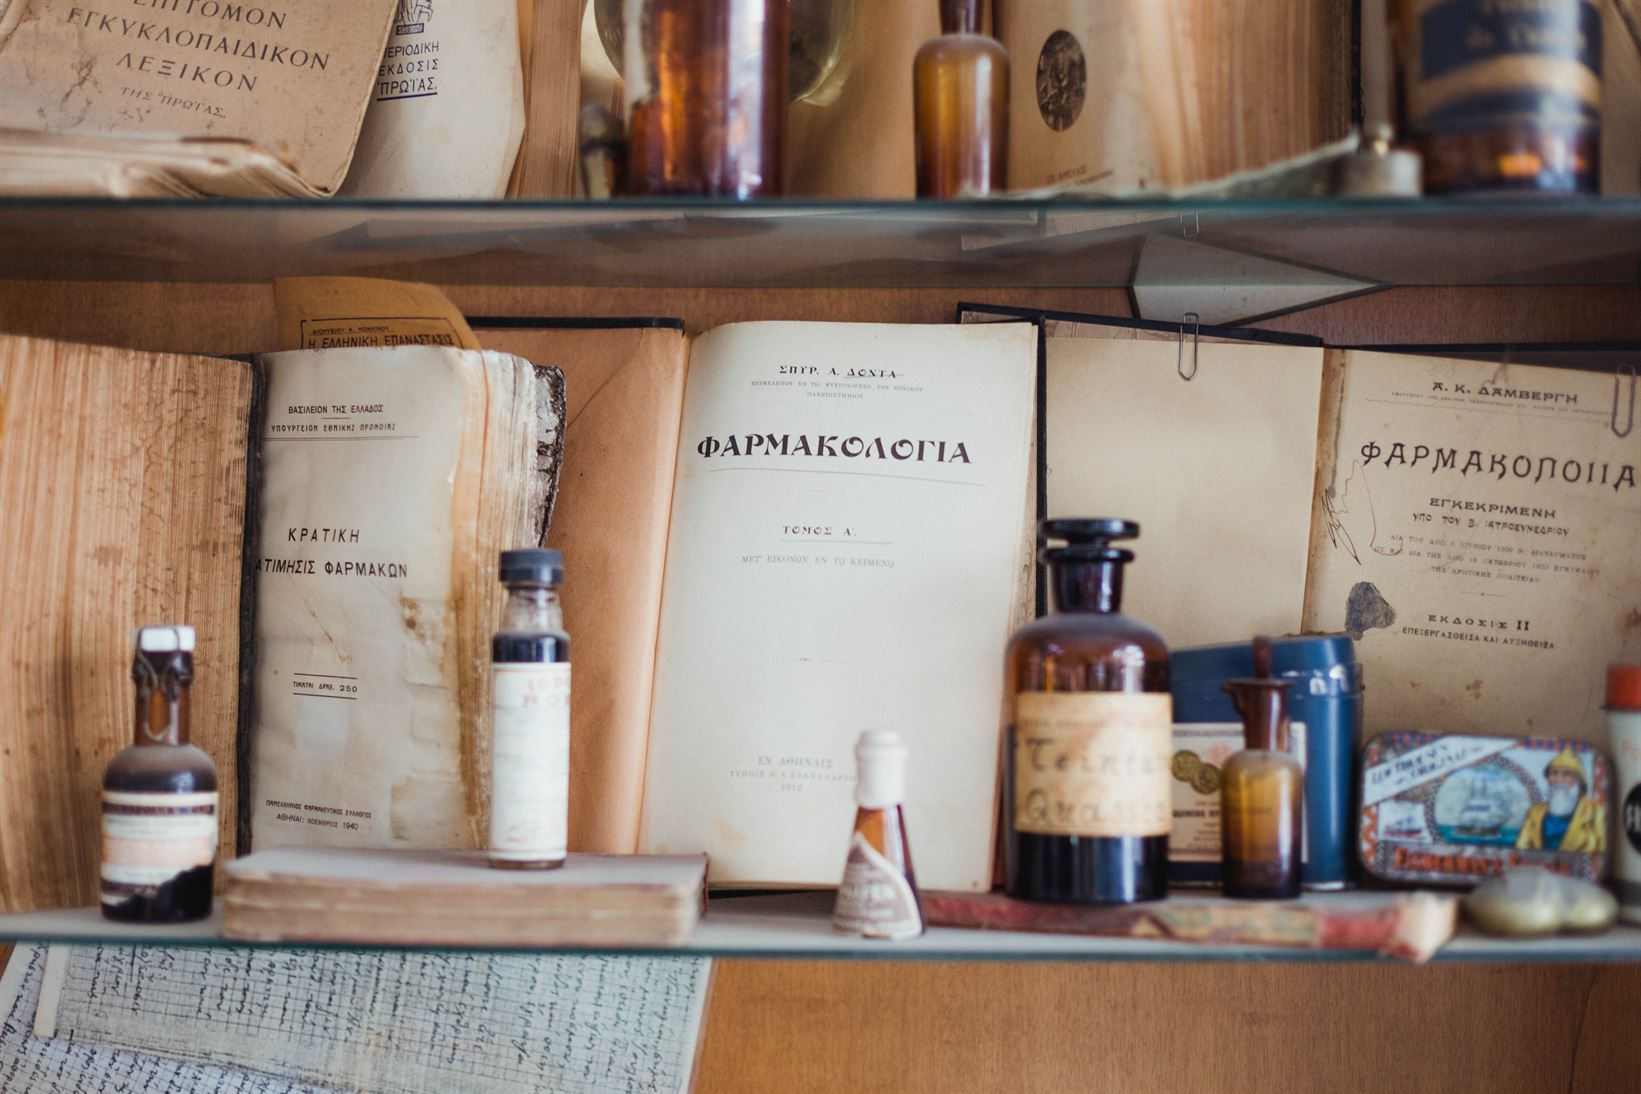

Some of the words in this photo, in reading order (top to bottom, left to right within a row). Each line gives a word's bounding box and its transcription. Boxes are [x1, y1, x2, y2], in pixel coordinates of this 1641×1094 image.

[67, 6, 329, 71] ΕΓΚΥΚΛΟΠΑΙΔΙΚΟΝ
[116, 52, 258, 92] ΛΕΞΙΚΟΝ
[379, 59, 439, 76] ΕΚΔΟΣΙΣ
[121, 86, 153, 101] ΤΗΣ
[322, 336, 378, 349] ΕΛΛΗΝΙΚΗ
[384, 334, 455, 346] ΕΠΑΝΑΣΤΑΣΙΣ
[847, 368, 897, 379] ΔΟΝΤΑ
[1477, 385, 1579, 404] ΔΑΜΒΕΡΓΗ
[288, 405, 328, 414] ΒΑΣΙΛΕΙΟΝ
[332, 405, 347, 414] ΤΗΣ
[351, 404, 384, 414] ΕΛΛΑΔΟΣ
[271, 424, 319, 432] ΥΠΟΥΡΓΕΙΟΝ
[698, 433, 972, 464] ΦΑΡΜΑΚΟΛΟΓΙΑ
[1430, 498, 1557, 519] ΕΓΚΕΚΡΙΜΕΝΗ
[1413, 513, 1433, 522] ΥΠΟ
[1442, 516, 1461, 526] ΤΟΥ
[288, 527, 360, 543] ΚΡΑΤΙΚΗ
[783, 525, 832, 536] ΤΟΜΟΣ
[325, 561, 408, 578] ΦΑΡΜΑΚΩΝ
[1428, 614, 1508, 630] ΕΚΔΟΣΙΣ
[340, 684, 358, 693] 250
[343, 821, 359, 831] 1940
